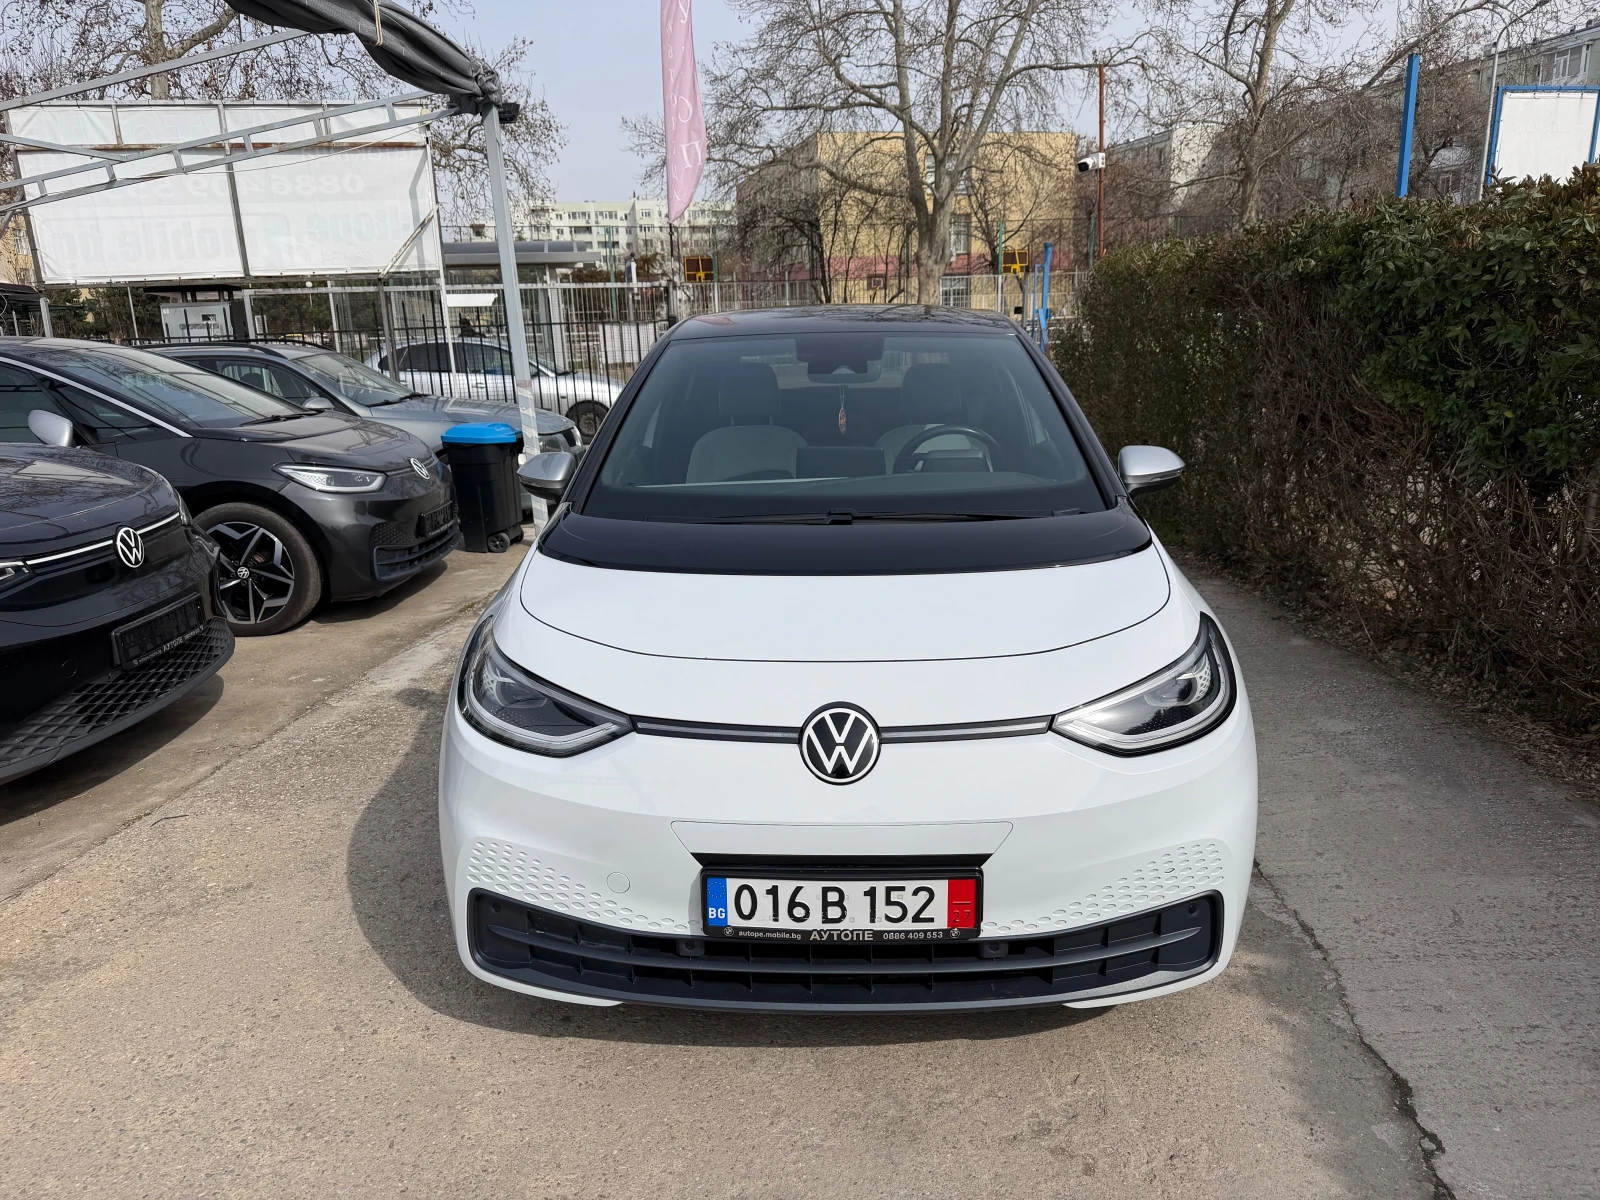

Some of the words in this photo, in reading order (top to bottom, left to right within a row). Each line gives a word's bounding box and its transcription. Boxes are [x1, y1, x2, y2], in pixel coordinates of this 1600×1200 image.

[708, 908, 726, 919] BG
[738, 930, 802, 940] autope.mobile.bg
[882, 932, 906, 940] 0886
[907, 931, 925, 940] 409
